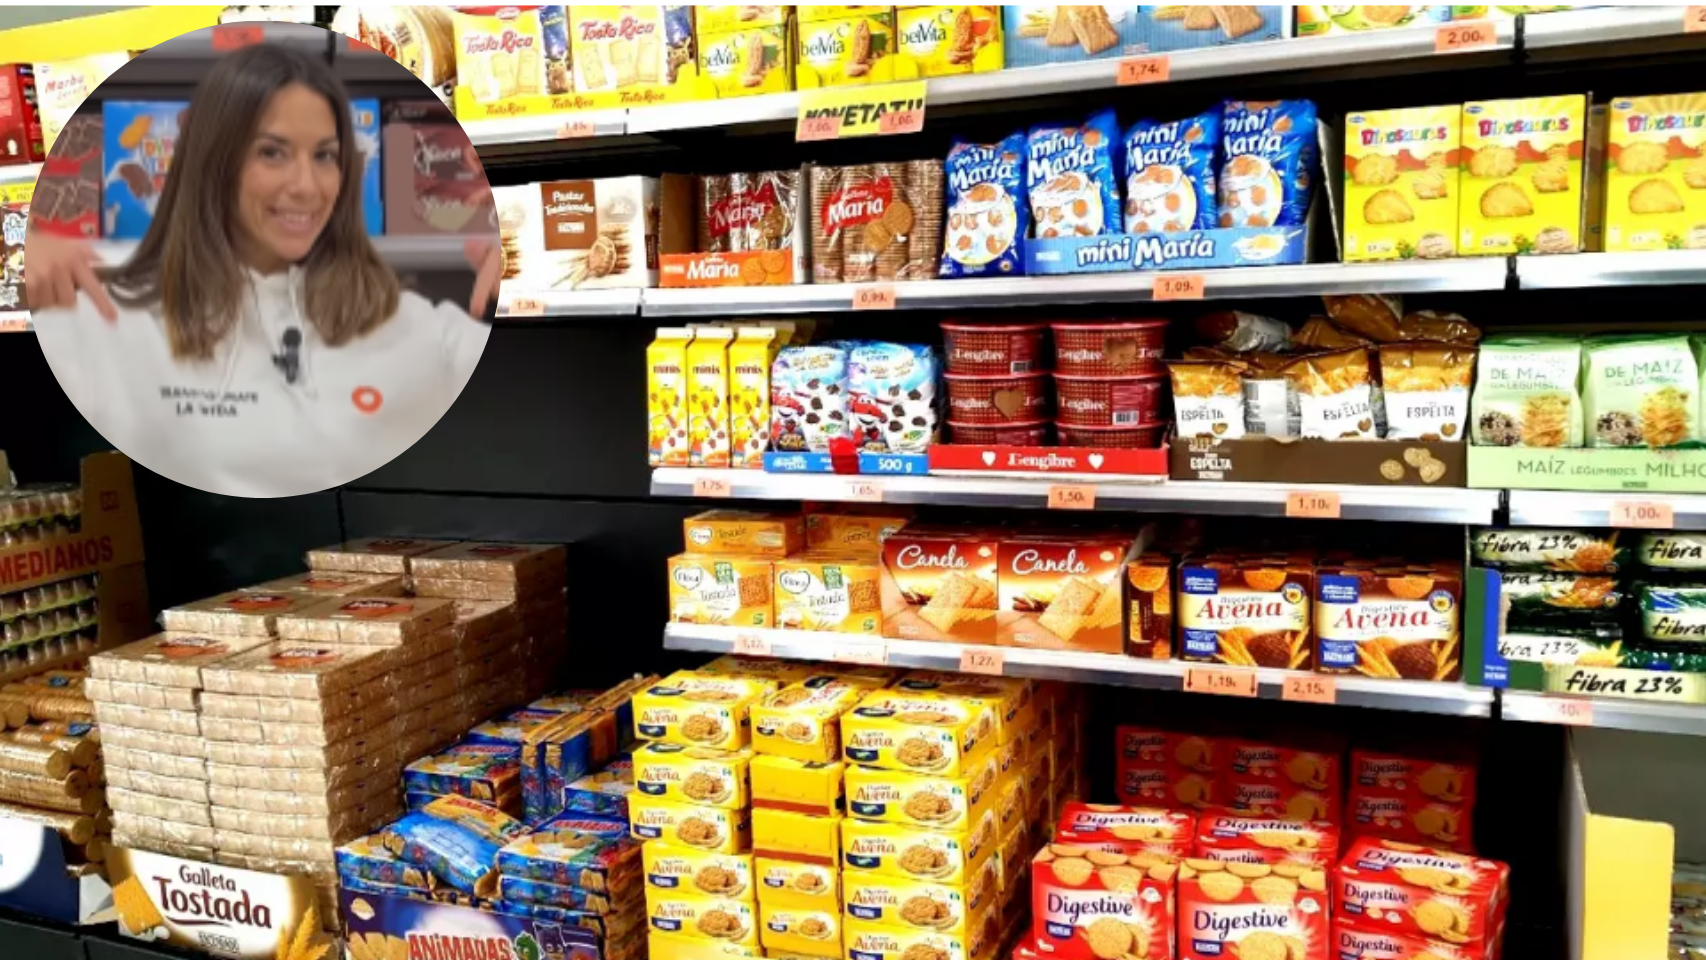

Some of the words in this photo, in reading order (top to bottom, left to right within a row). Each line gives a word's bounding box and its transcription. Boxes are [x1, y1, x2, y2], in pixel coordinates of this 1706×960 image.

[1030, 131, 1077, 158] mini
[955, 147, 995, 168] mini
[1027, 145, 1095, 187] María
[948, 157, 1013, 190] María
[828, 194, 884, 226] María
[1077, 238, 1131, 267] mini
[1134, 233, 1215, 267] María
[687, 258, 740, 280] María
[653, 363, 681, 374] minis
[693, 363, 720, 374] minis
[735, 363, 763, 374] minis
[1605, 366, 1626, 379] DE
[878, 459, 902, 471] 500
[906, 462, 913, 473] g
[1517, 455, 1566, 475] MAÍZ
[1482, 533, 1531, 553] fibra
[1538, 534, 1578, 551] 23%
[1649, 539, 1702, 559] fibra
[0, 535, 114, 585] MEDIANOS
[897, 544, 969, 570] Canela
[1012, 548, 1089, 575] Canela
[1195, 599, 1284, 620] Avena
[1333, 607, 1431, 630] Avena
[1653, 616, 1706, 636] fibra
[1541, 641, 1580, 656] 23%
[1567, 670, 1626, 693] fibra
[1633, 677, 1683, 694] 23%
[642, 711, 678, 723] Avena
[850, 734, 894, 747] Avena
[642, 768, 681, 782] Avena
[855, 787, 902, 801] Avena
[636, 812, 677, 826] Avena
[1075, 813, 1161, 826] Digestive
[1214, 818, 1303, 832] Digestive
[851, 839, 896, 853] Avena
[652, 861, 693, 875] Avena
[1364, 850, 1462, 870] Digestive
[178, 864, 237, 892] Galleta
[152, 876, 272, 929] Tostada
[852, 890, 899, 905] Avena
[1344, 883, 1409, 905] Digestive
[654, 903, 696, 918] Avena
[1046, 892, 1134, 924] Digestive
[1193, 908, 1288, 940] Digestive
[407, 932, 512, 960] ANIMADAS
[854, 936, 901, 952] Avena
[1341, 933, 1404, 955] Digestive
